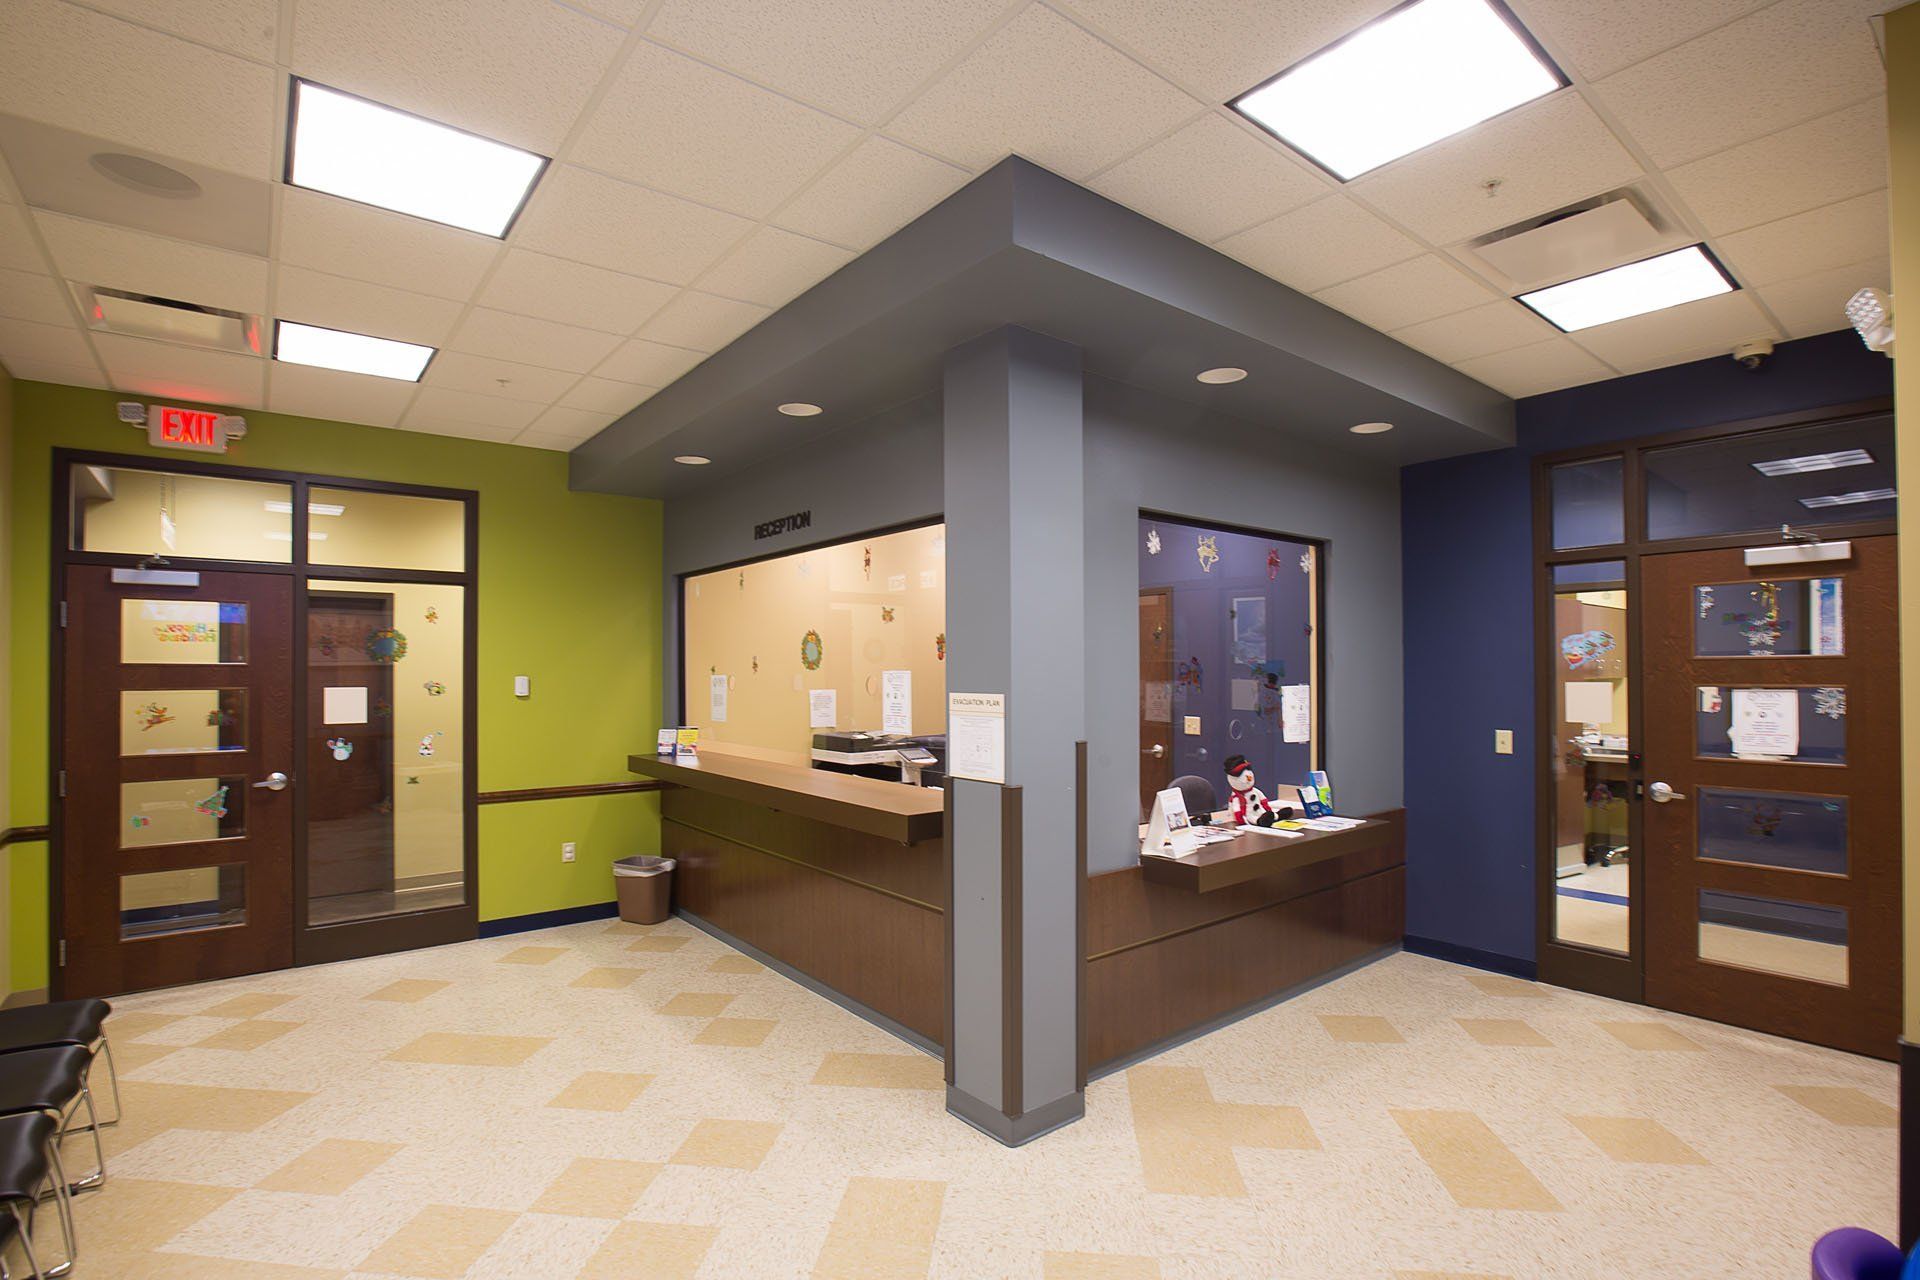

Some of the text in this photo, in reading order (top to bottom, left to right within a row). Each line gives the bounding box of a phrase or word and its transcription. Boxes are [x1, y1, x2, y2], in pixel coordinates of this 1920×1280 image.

[162, 408, 217, 445] EXIT
[754, 510, 811, 540] RECEPTION
[952, 698, 1001, 707] EVACUATION PLAN
